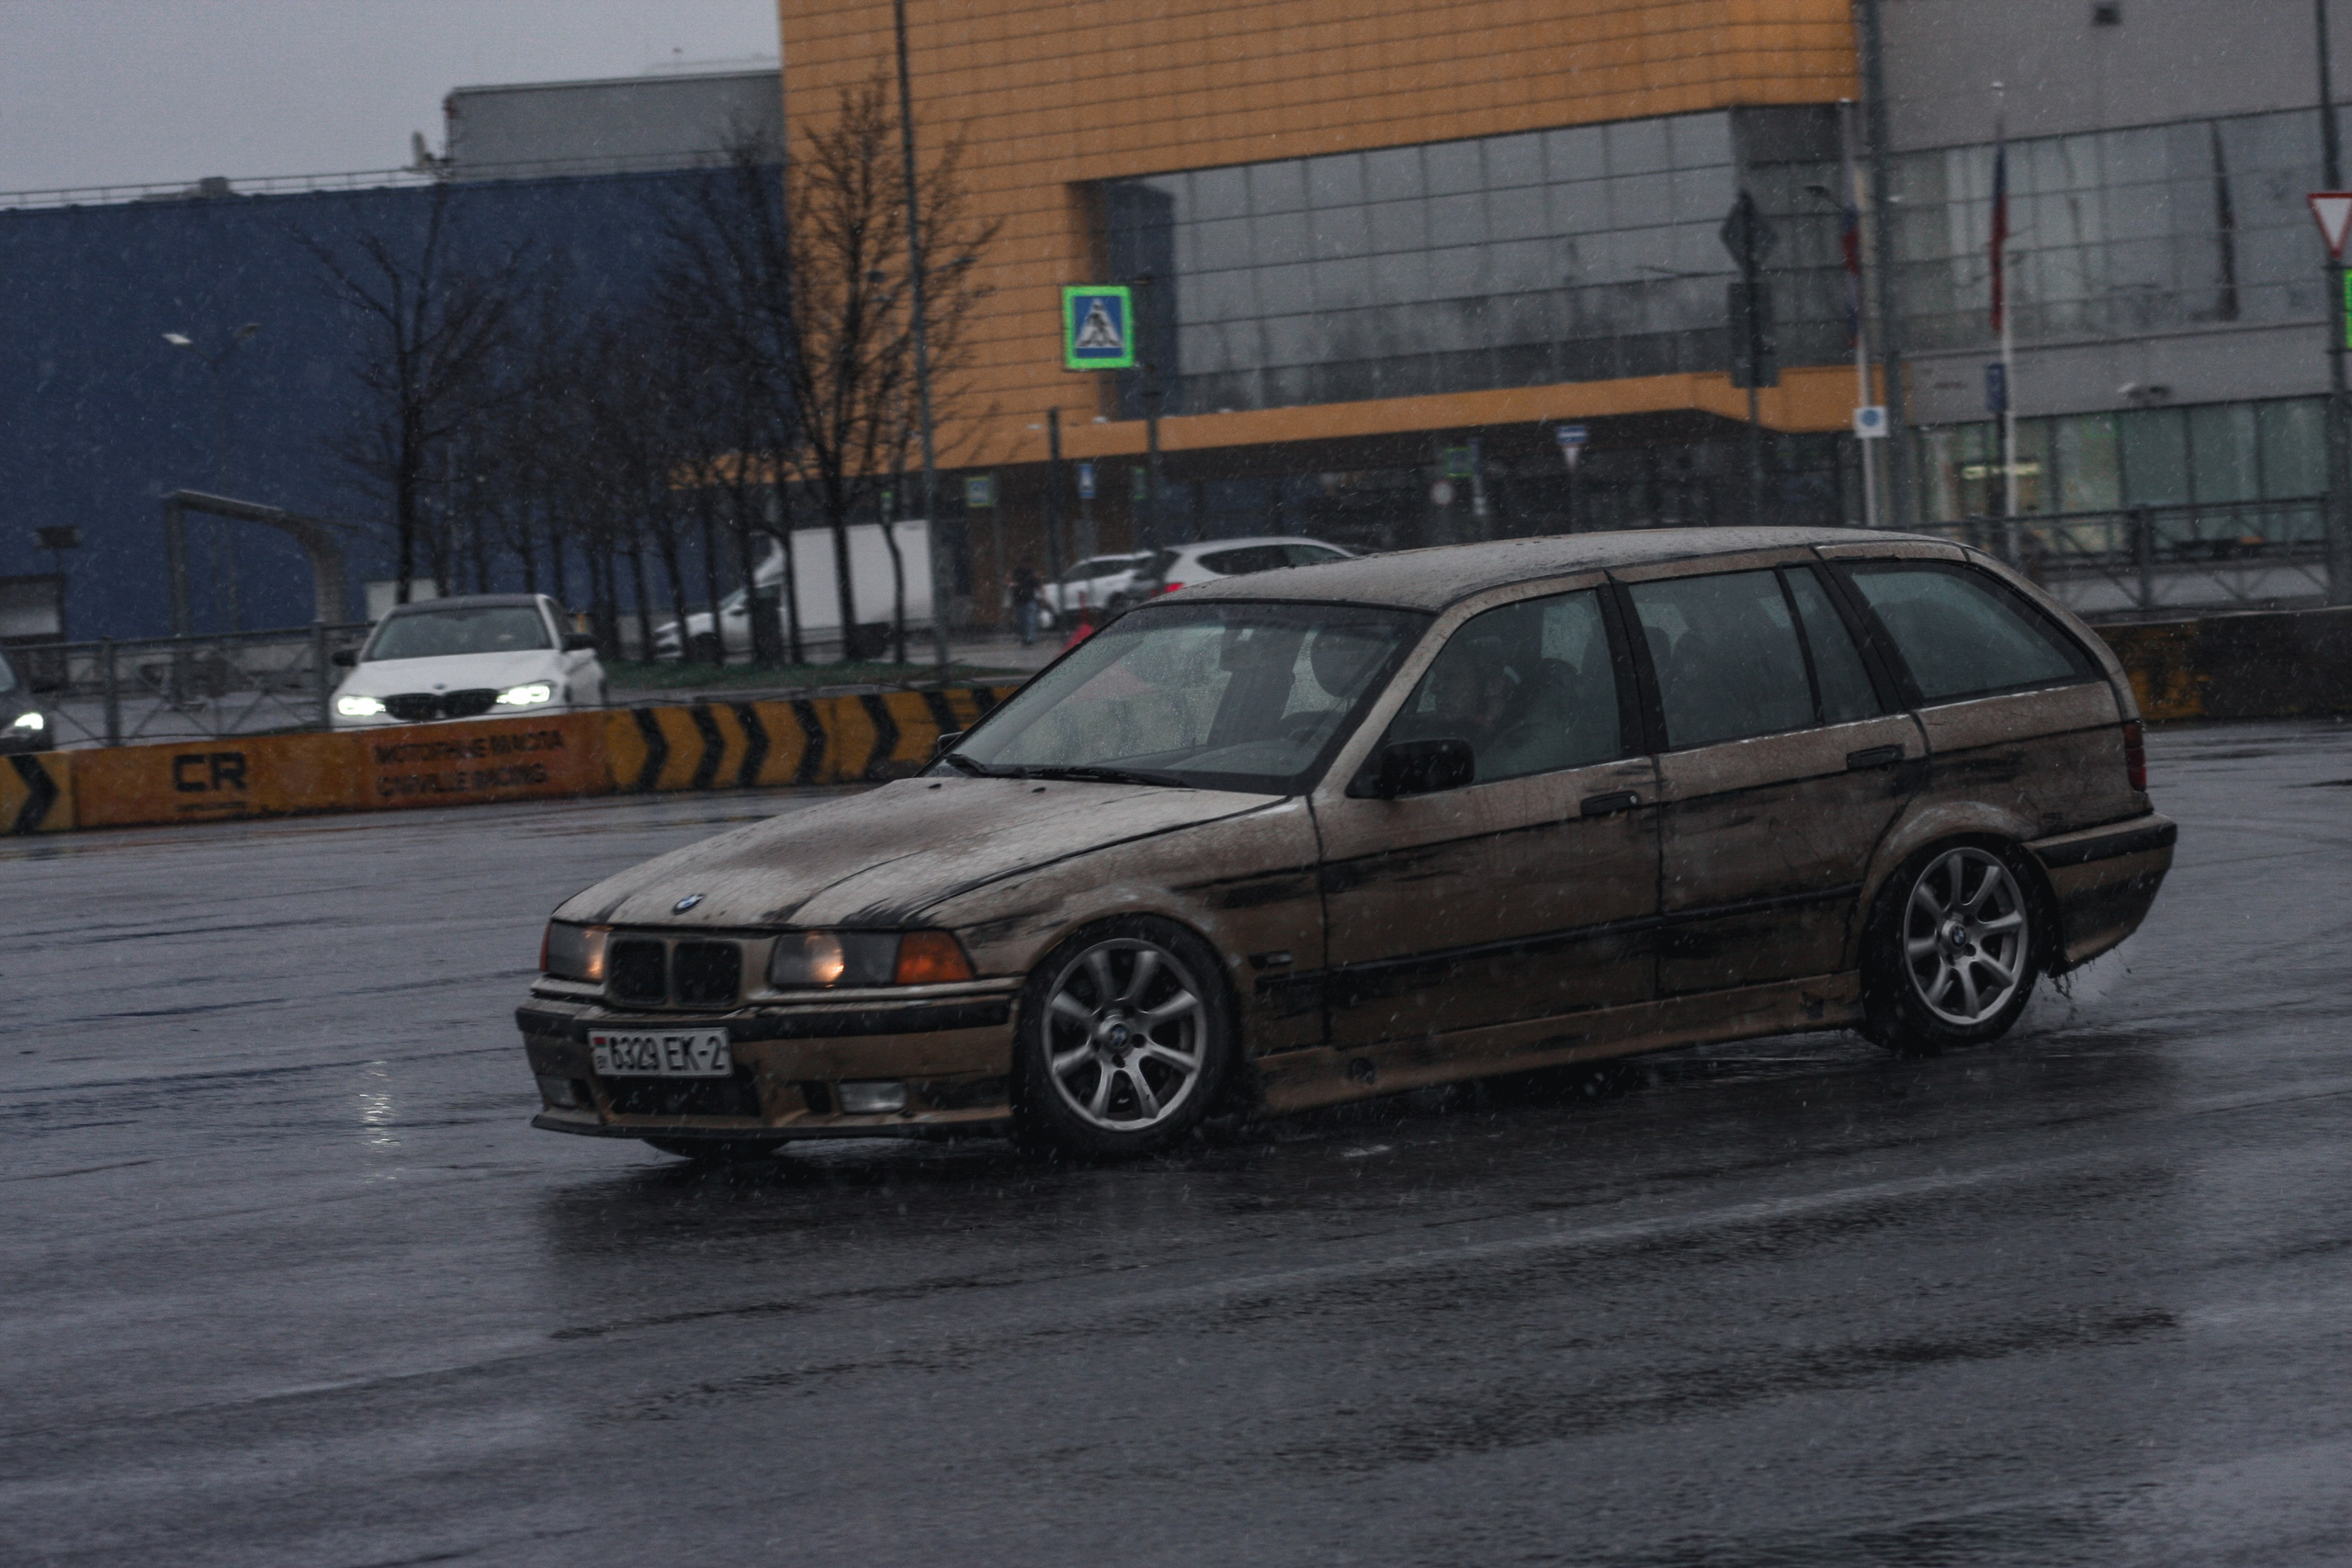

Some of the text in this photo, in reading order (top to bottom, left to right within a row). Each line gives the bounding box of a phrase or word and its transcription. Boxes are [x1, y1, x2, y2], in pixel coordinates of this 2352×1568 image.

[173, 751, 247, 792] CR
[609, 1035, 725, 1071] 6329 EK-2
